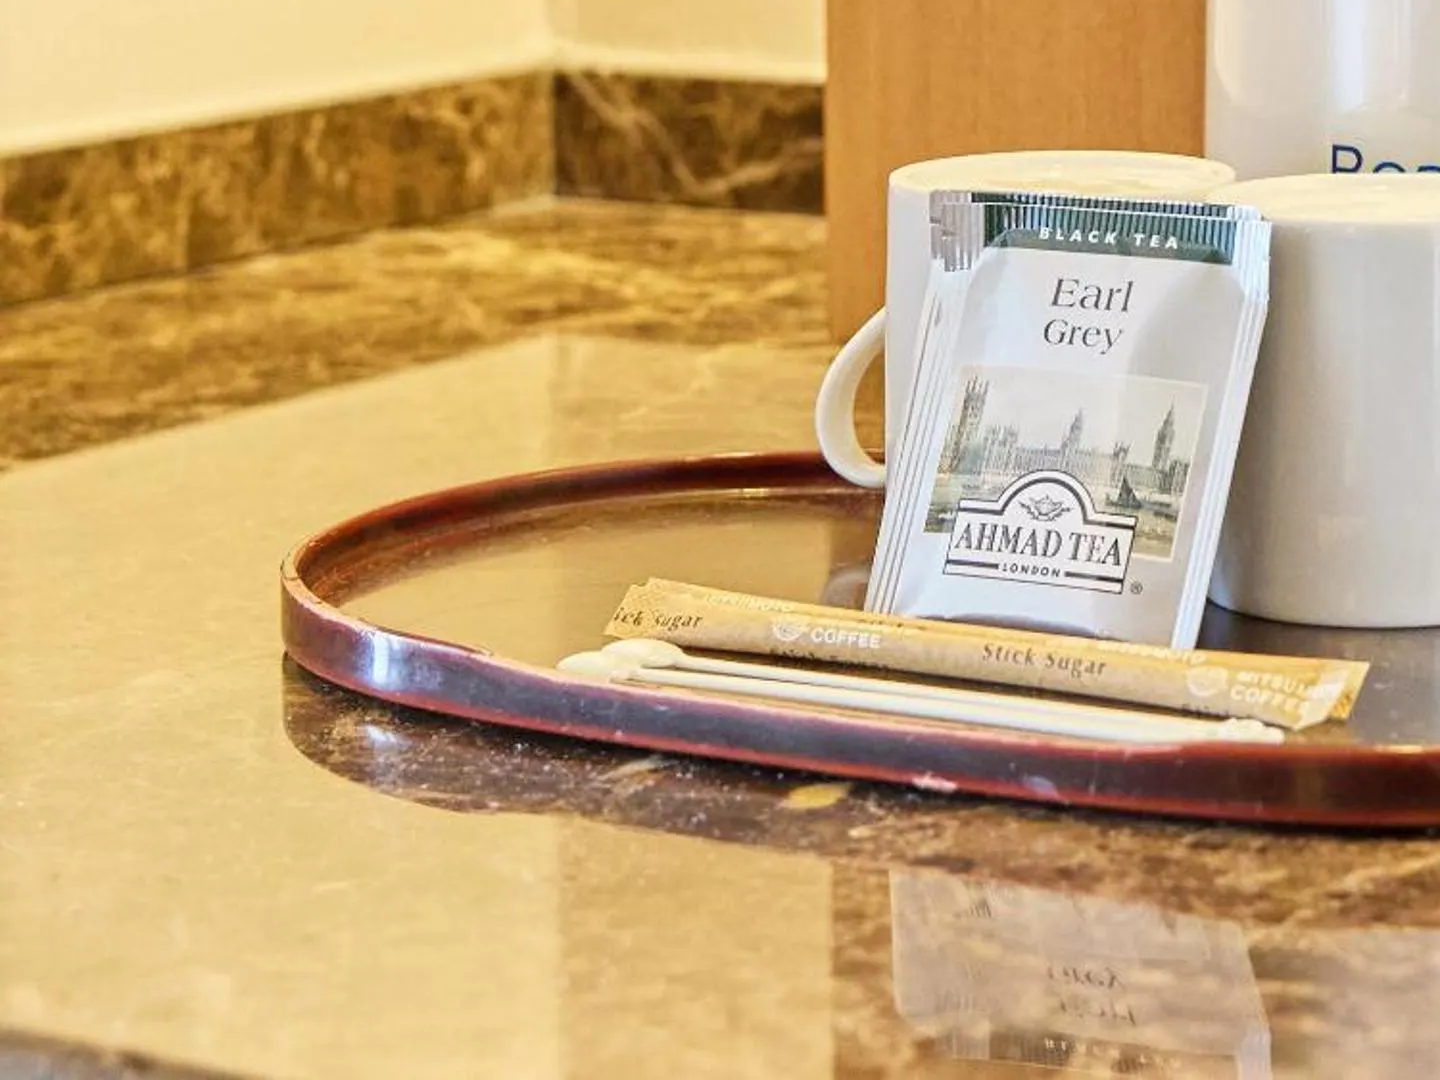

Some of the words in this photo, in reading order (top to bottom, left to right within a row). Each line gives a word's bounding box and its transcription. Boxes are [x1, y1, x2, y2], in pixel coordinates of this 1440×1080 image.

[1037, 226, 1118, 246] BLACK
[1133, 234, 1180, 250] TEA
[1049, 277, 1134, 314] Earl
[1043, 319, 1125, 355] Grey
[953, 520, 1063, 558] AHMAD
[1068, 532, 1121, 567] TEA
[1001, 563, 1062, 578] LONDON
[810, 628, 883, 650] COFFEE
[981, 642, 1034, 666] Stick
[1044, 652, 1106, 678] Sugar
